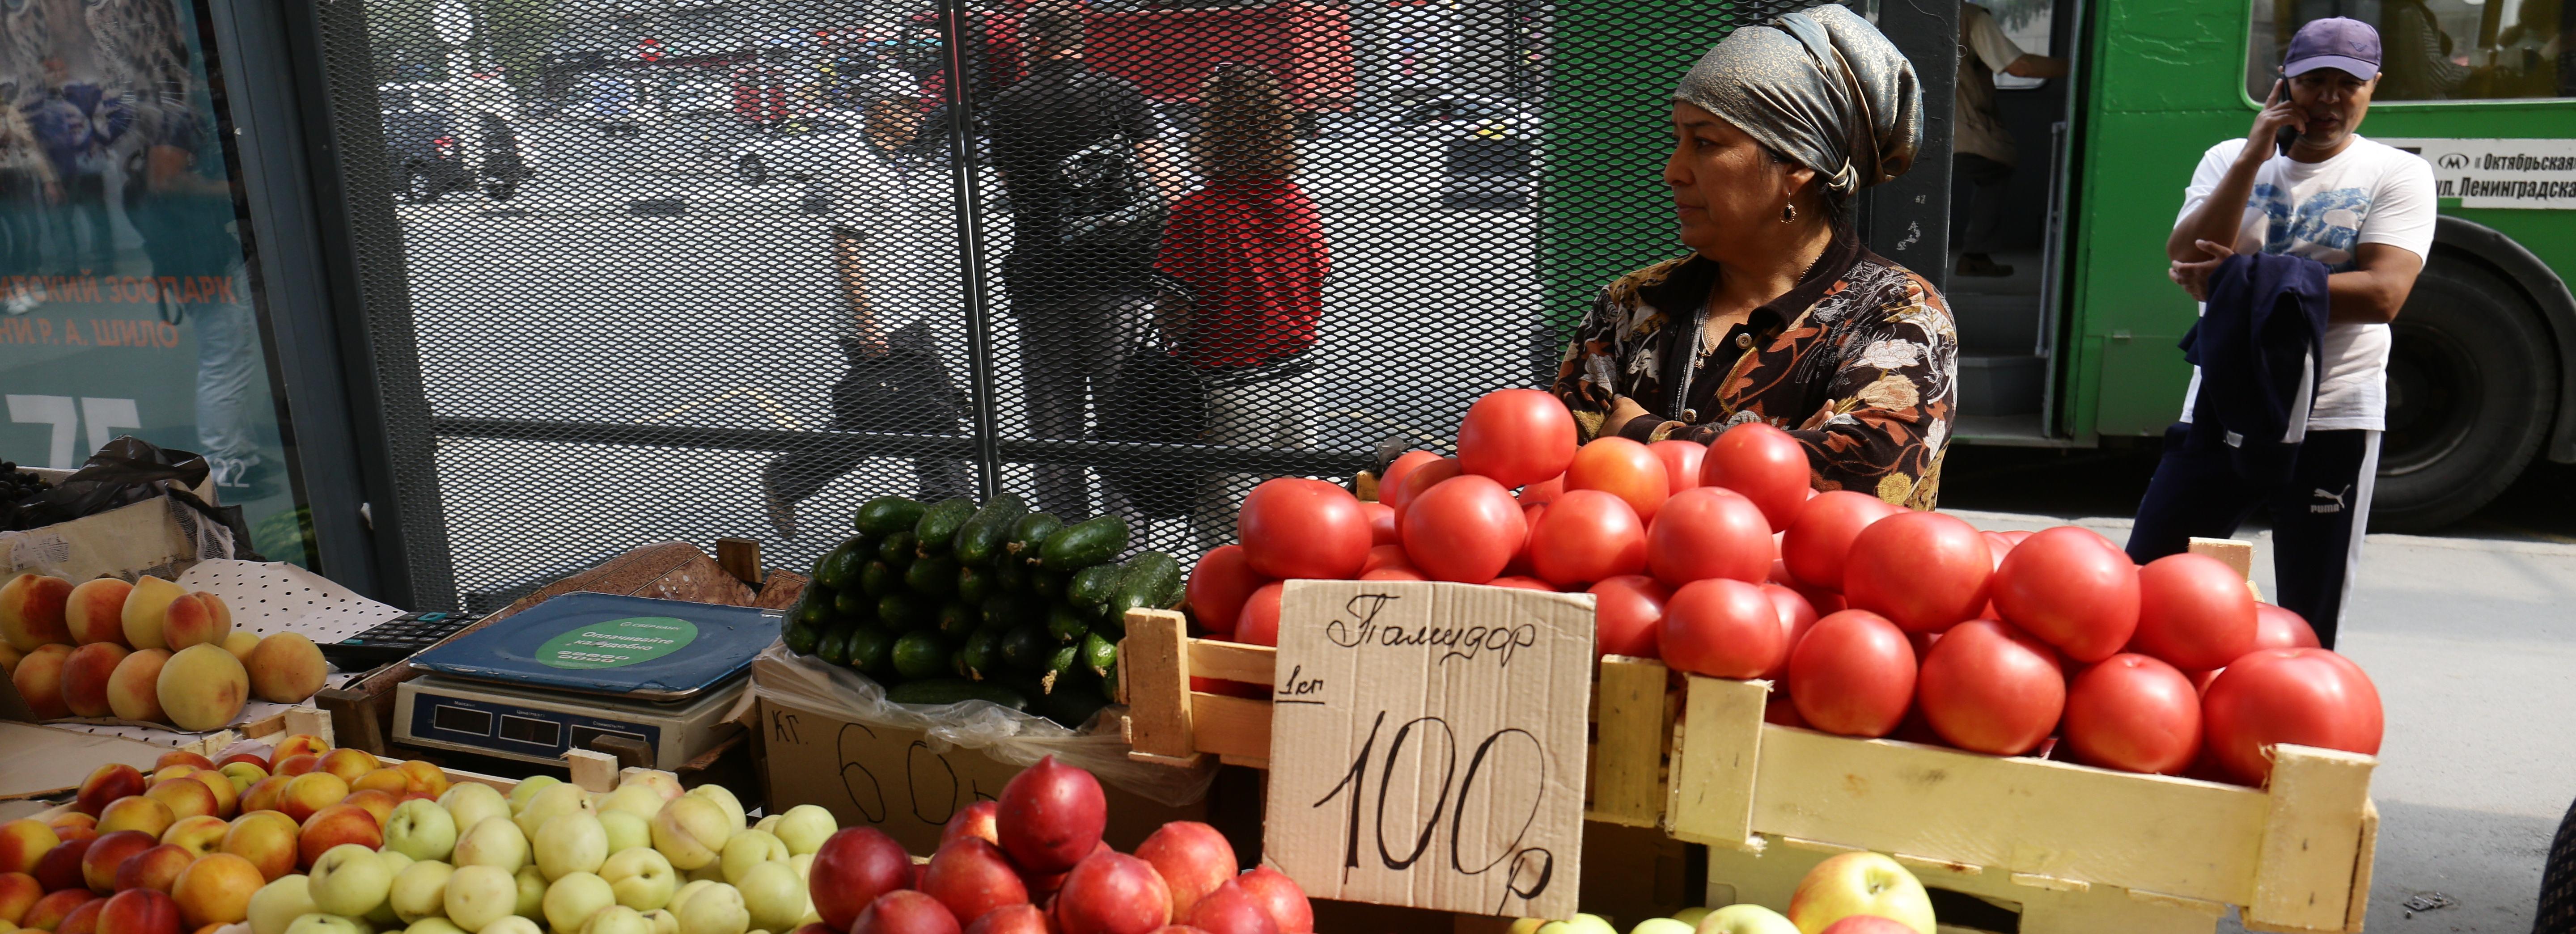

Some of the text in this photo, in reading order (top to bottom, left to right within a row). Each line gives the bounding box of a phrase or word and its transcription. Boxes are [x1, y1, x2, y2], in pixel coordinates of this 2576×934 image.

[105, 276, 237, 304] ЗООПАРК
[38, 318, 59, 344] Р.
[65, 319, 88, 345] А.
[91, 320, 178, 348] ШИЛО
[2310, 504, 2340, 513] PUMA
[582, 631, 674, 644] Оплачивайте
